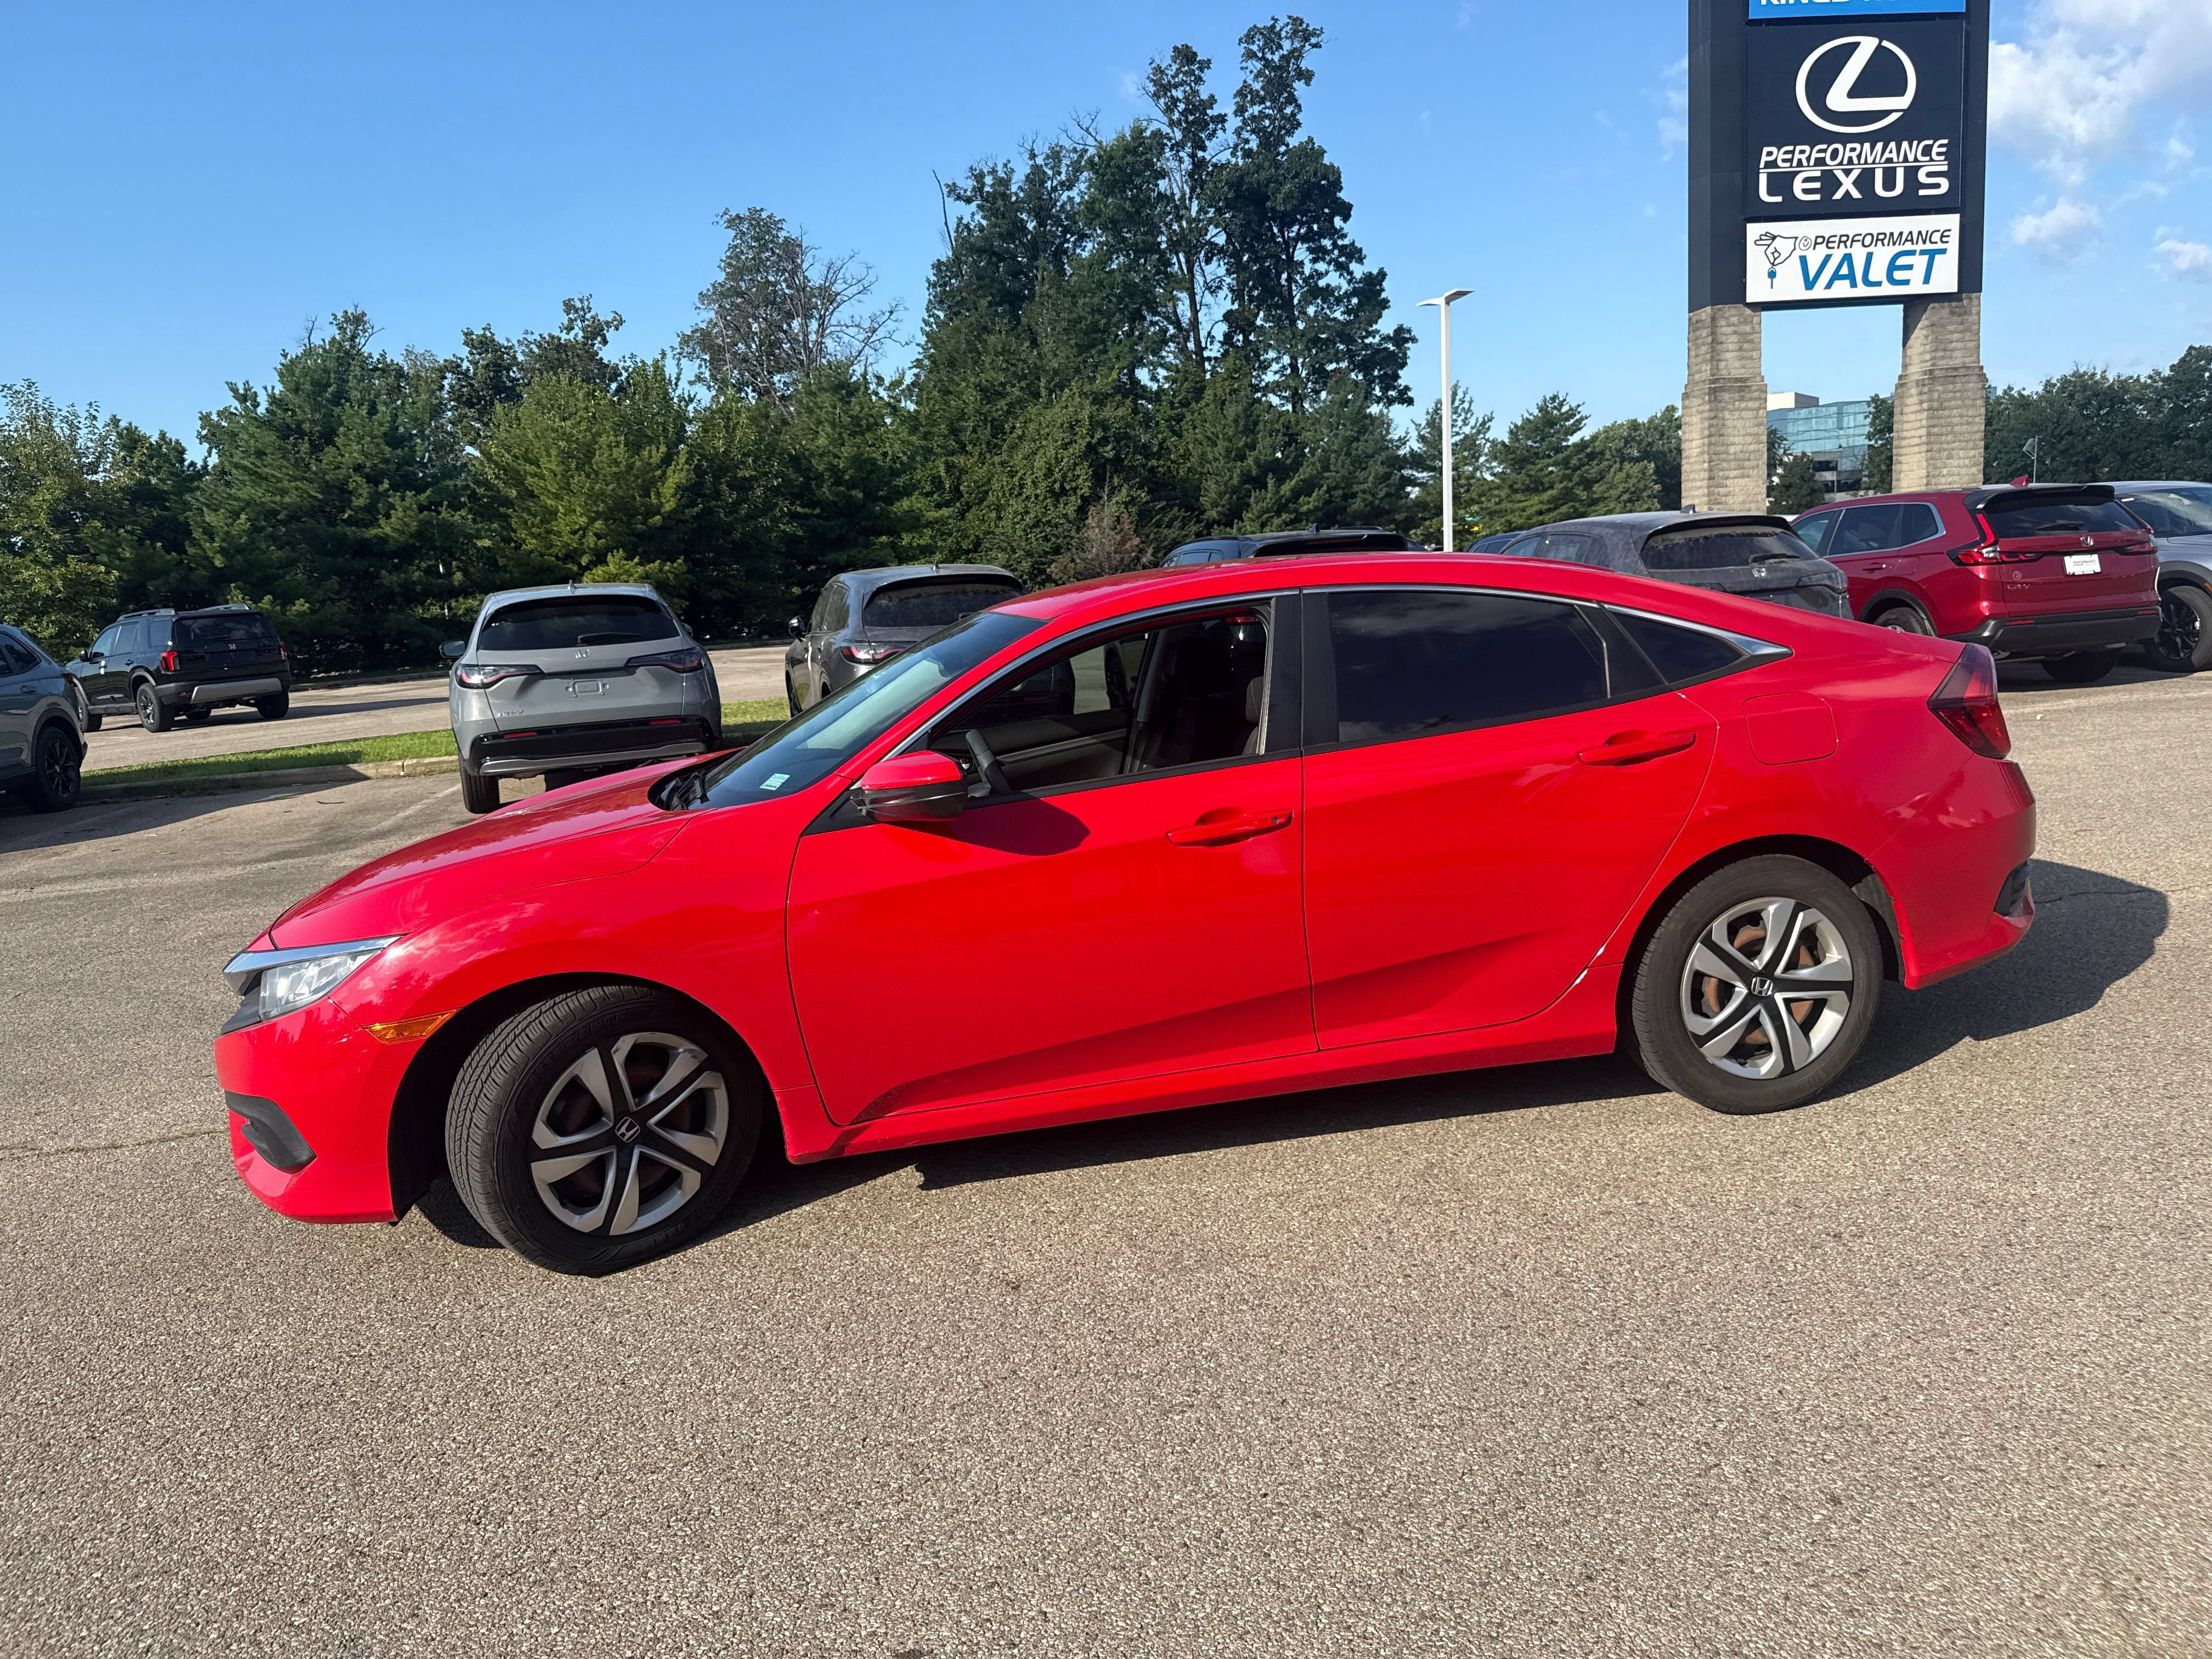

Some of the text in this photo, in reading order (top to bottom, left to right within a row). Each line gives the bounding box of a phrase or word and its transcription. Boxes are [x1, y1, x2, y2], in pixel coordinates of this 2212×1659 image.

[1759, 139, 1949, 168] PERFORMANCE
[1758, 165, 1949, 202] LEXUS
[1813, 229, 1951, 250] PERFORMANCE
[1799, 247, 1947, 291] VALET
